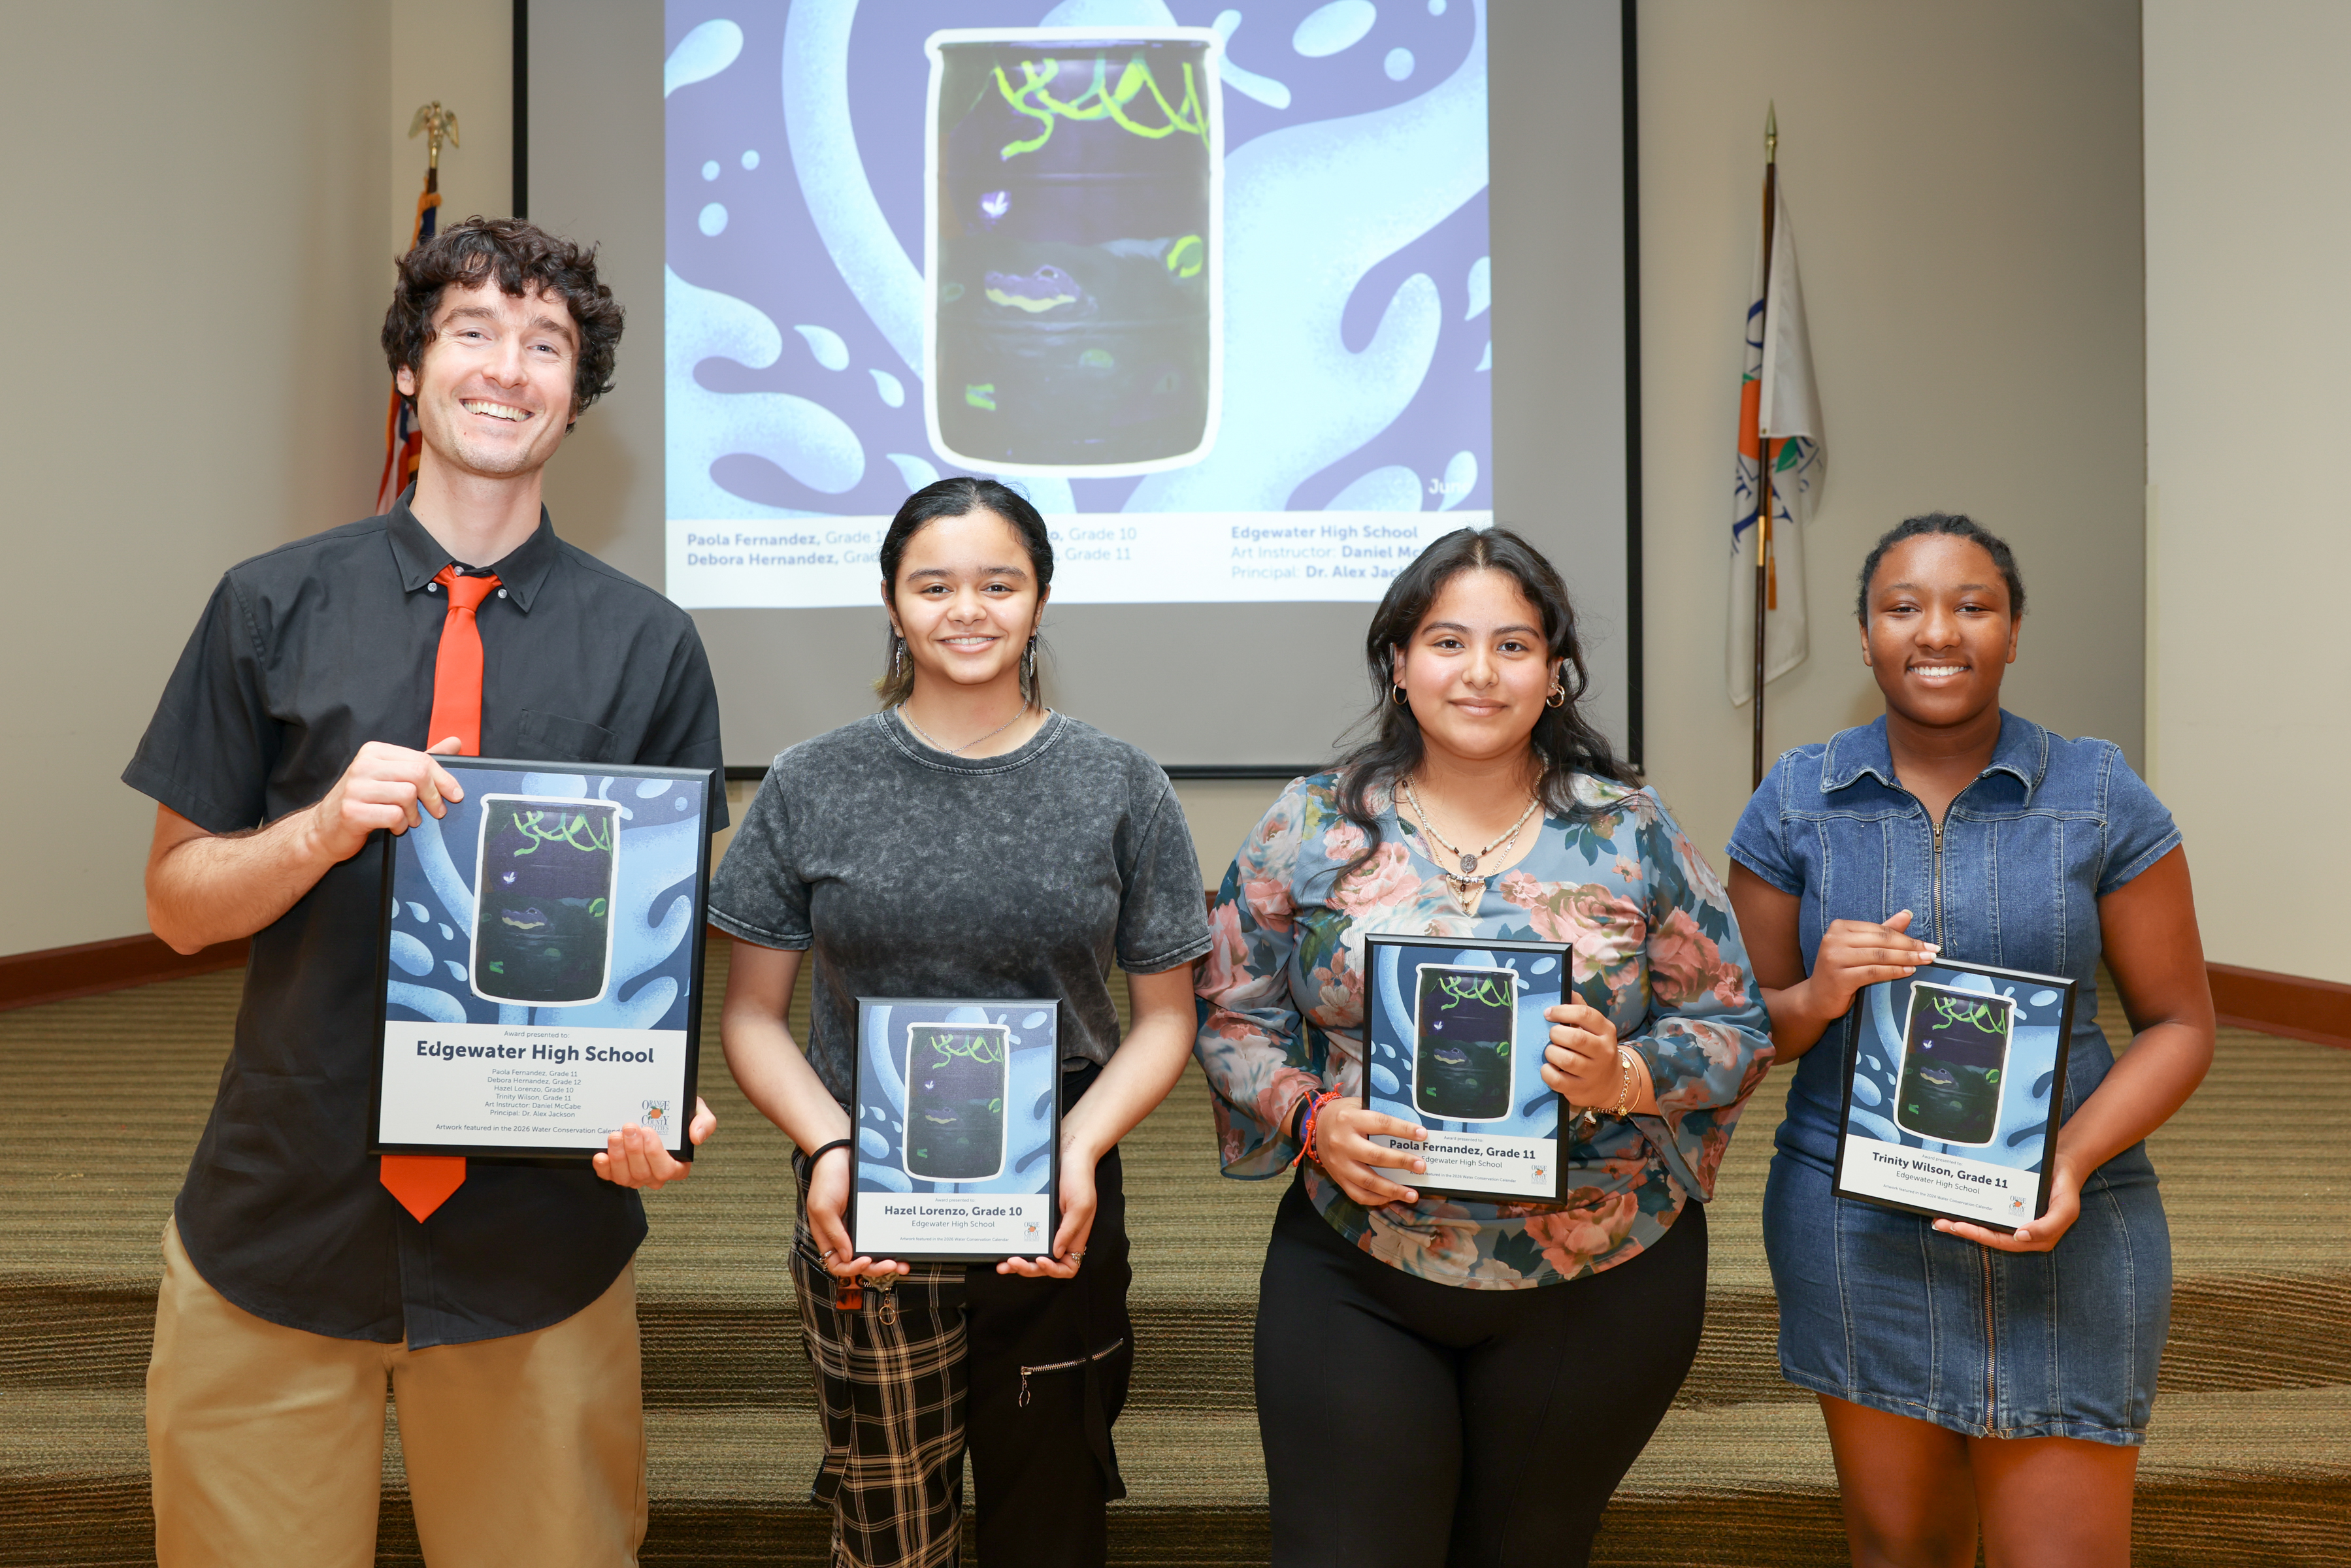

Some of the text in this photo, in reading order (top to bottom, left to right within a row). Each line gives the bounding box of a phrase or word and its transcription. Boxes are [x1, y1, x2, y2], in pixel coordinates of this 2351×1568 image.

[687, 533, 730, 546] Paola
[736, 533, 820, 546] Fernandez,
[825, 531, 871, 544] Grade
[1069, 527, 1115, 541] Grade
[1120, 527, 1137, 540] 10
[1232, 525, 1418, 542] Edgewater High School
[687, 553, 744, 566] Debora
[749, 553, 838, 565] Hernandez,
[1064, 547, 1131, 561] Grade 11
[1231, 546, 1253, 559] Art
[1258, 546, 1336, 559] Instructor:
[1342, 546, 1392, 558] Daniel
[1232, 566, 1299, 581] Principal:
[1306, 566, 1327, 578] Dr.
[1332, 566, 1366, 578] Alex
[417, 1041, 653, 1064] Edgewater High School
[642, 1100, 670, 1111] ORANGE
[642, 1115, 670, 1125] COUNTY
[1390, 1139, 1536, 1159] Paola Fernandez, Grade 11
[1873, 1152, 2007, 1188] Trinity Wilson, Grade 11
[1896, 1171, 1980, 1194] Edgewater High School
[1949, 1198, 1975, 1207] Conservation
[885, 1206, 1022, 1217] Hazel Lorenzo, Grade 10
